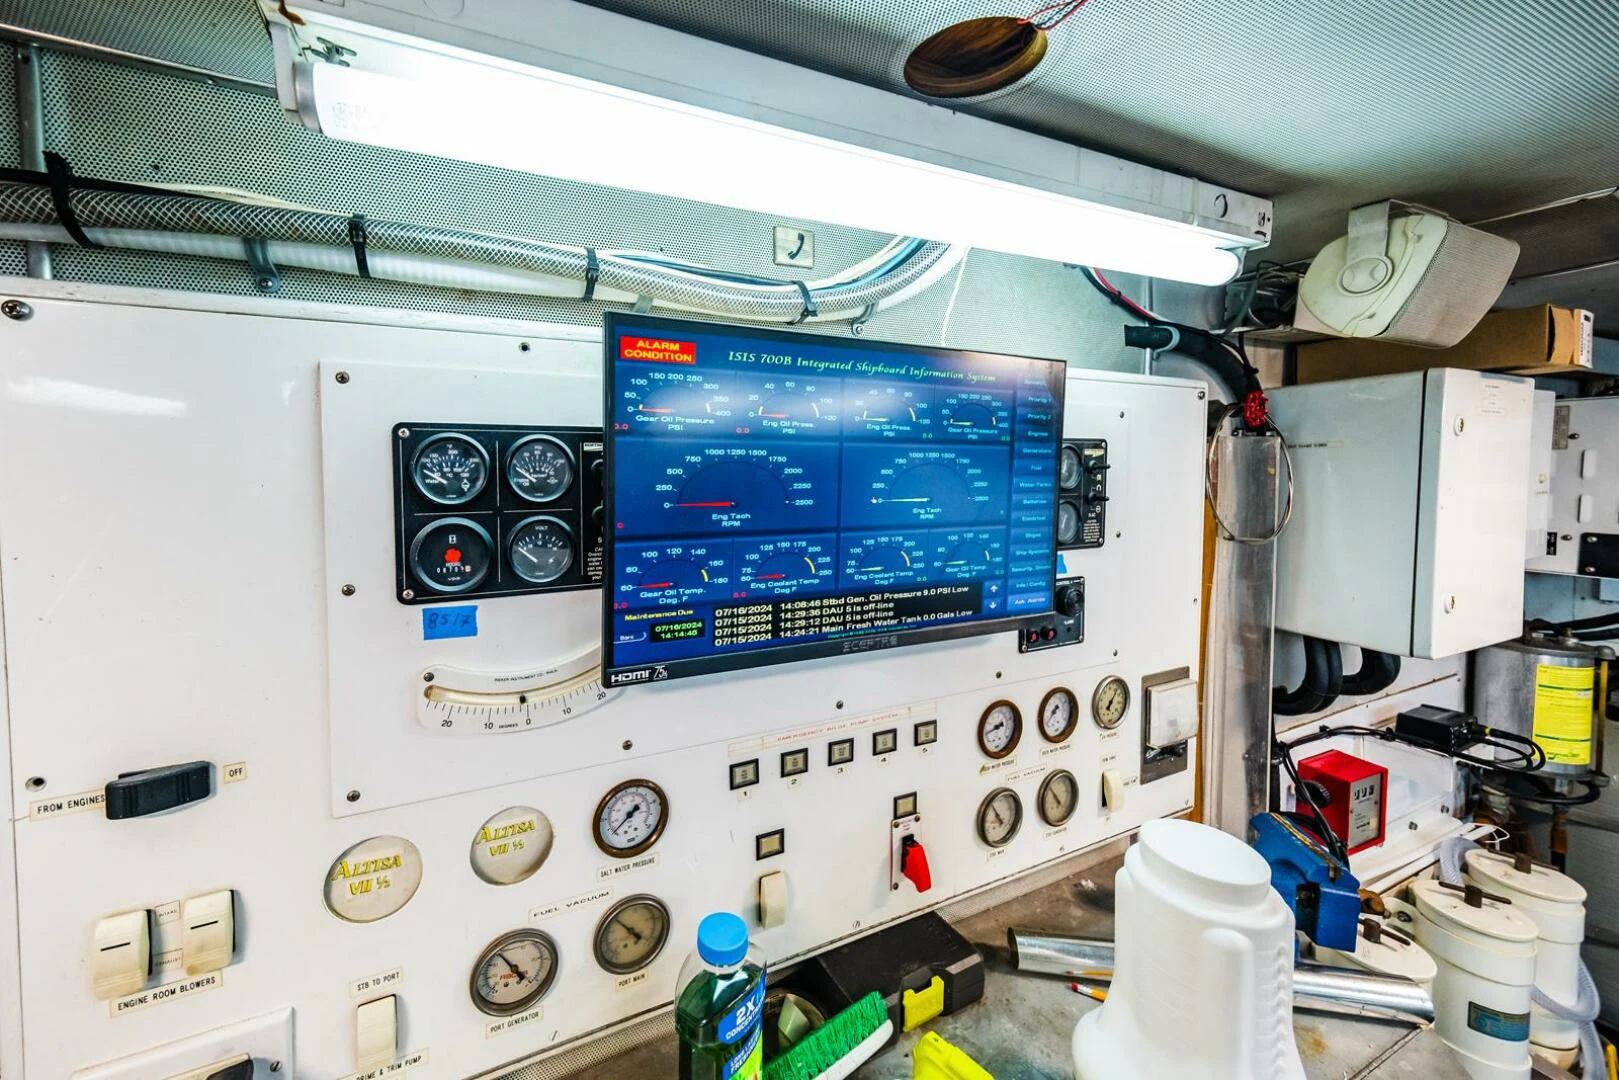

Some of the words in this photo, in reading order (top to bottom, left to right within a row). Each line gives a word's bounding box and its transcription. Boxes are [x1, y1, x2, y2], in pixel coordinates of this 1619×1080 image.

[636, 340, 680, 350] ALARM
[624, 349, 692, 362] CONDITION
[728, 351, 756, 362] ISIS
[761, 355, 792, 366] 700B
[796, 357, 852, 372] Integrated
[855, 362, 906, 376] Shipboard
[909, 366, 964, 380] Information
[967, 371, 997, 383] System
[649, 372, 665, 380] 150
[630, 378, 648, 386] 100
[636, 414, 658, 422] Gear
[674, 416, 714, 424] Pressure
[762, 420, 778, 428] Eng
[780, 420, 791, 428] Oil
[705, 448, 724, 456] 1000
[727, 448, 746, 456] 1250
[793, 482, 812, 490] 2250
[722, 520, 740, 528] RPM
[690, 548, 706, 556] 140
[620, 584, 632, 592] 60
[750, 582, 766, 590] Eng
[768, 580, 798, 588] Coolant
[799, 578, 819, 586] Temp
[640, 590, 662, 598] Gear
[678, 588, 706, 596] Temp.
[715, 604, 772, 617] 07/16/2024
[780, 600, 820, 610] 14:08:46
[822, 596, 845, 606] Stbd
[847, 595, 868, 604] Gen.
[884, 590, 922, 600] Pressure
[924, 588, 936, 596] 9.0
[624, 611, 676, 622] Maintenance
[677, 608, 694, 616] Due
[714, 614, 772, 627] 07/15/2024
[780, 608, 820, 620] 14:29:36
[822, 606, 844, 615] DAU
[862, 601, 894, 610] off-line
[655, 622, 702, 632] 07/16/2024
[714, 623, 772, 637] 07/15/2024
[780, 618, 820, 628] 14:29:12
[822, 614, 844, 624] DAU
[853, 612, 861, 620] is
[862, 610, 894, 618] off-line
[714, 633, 772, 646] 07/15/2024
[780, 628, 820, 638] 14:24:21
[822, 624, 844, 634] Main
[846, 620, 872, 630] Fresh
[873, 618, 900, 627] Water
[902, 615, 922, 624] Tank
[924, 613, 936, 622] 0.0
[956, 608, 973, 617] Low
[596, 691, 606, 700] 20
[562, 706, 572, 714] 10
[441, 720, 452, 728] 20
[484, 722, 494, 730] 10
[526, 718, 532, 726] 0
[229, 768, 244, 778] OFF
[37, 803, 63, 814] FROM
[68, 794, 105, 808] ENGINES
[476, 819, 536, 846] ALTISA
[331, 853, 403, 882] ALTISA
[600, 868, 613, 878] SALT
[614, 864, 630, 873] WATER
[632, 857, 655, 868] PRESSURE
[533, 908, 560, 918] FUEL
[566, 891, 610, 908] VACUUM
[357, 982, 370, 992] STB
[372, 978, 381, 987] TO
[383, 972, 400, 984] PORT
[618, 978, 632, 988] PORT
[634, 973, 646, 984] MAIN
[118, 996, 148, 1011] ENGINE
[152, 988, 176, 1001] ROOM
[180, 976, 216, 992] BLOWERS
[736, 994, 756, 1025] 2X
[490, 1024, 505, 1033] PORT
[507, 1012, 539, 1028] GENERATOR
[379, 1069, 384, 1077] &
[386, 1062, 402, 1073] TRIM
[405, 1056, 422, 1068] PUMP
